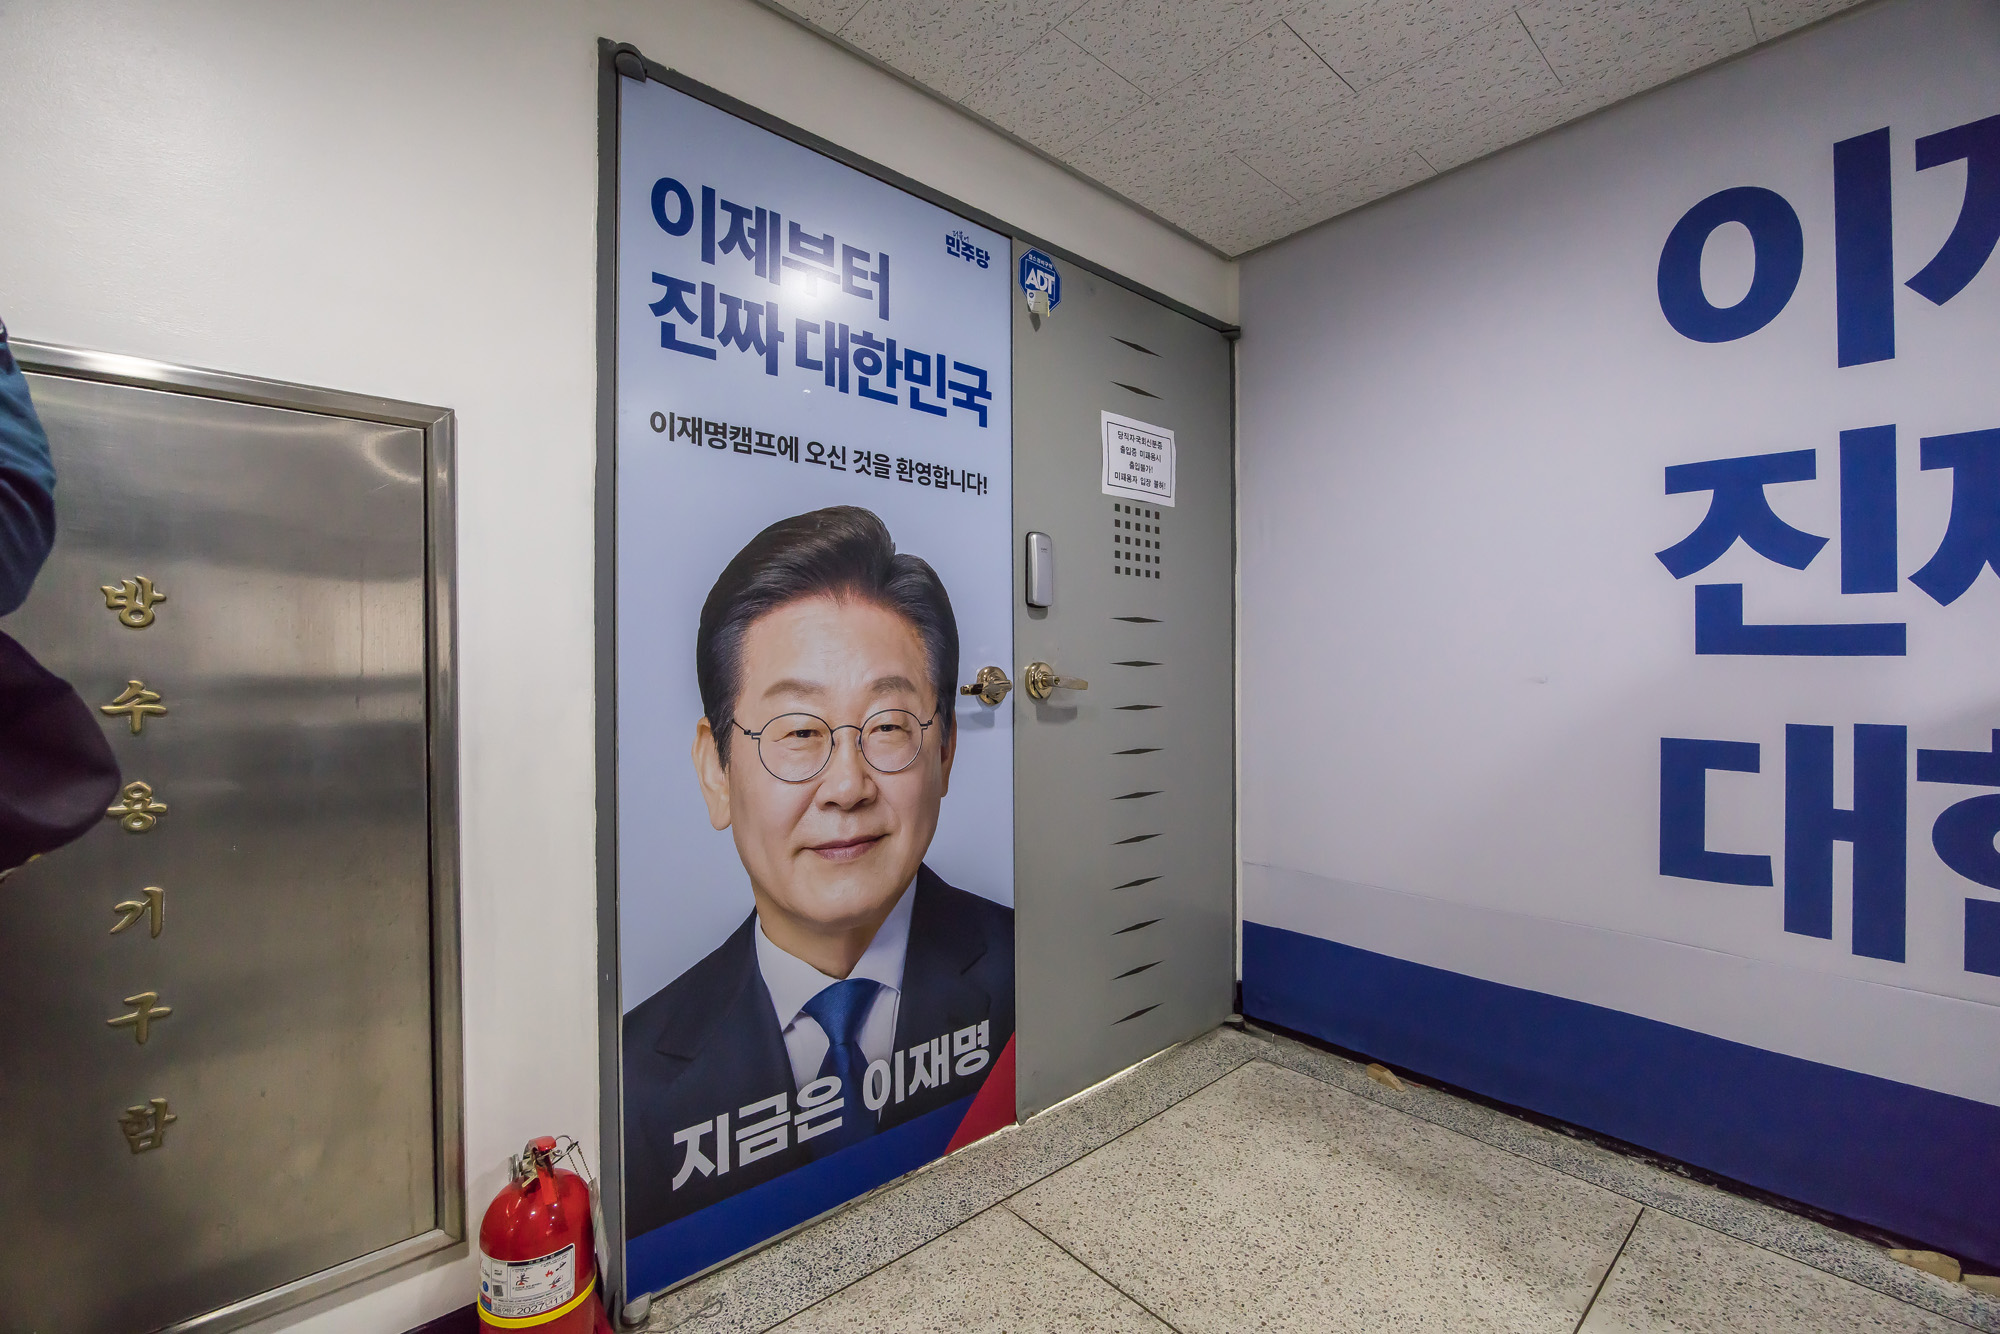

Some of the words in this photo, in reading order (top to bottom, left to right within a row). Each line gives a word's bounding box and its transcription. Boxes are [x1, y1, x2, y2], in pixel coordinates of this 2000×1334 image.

[651, 177, 889, 321] 이제부터
[945, 234, 990, 269] 민주당
[1025, 267, 1055, 295] ADT
[648, 271, 784, 377] 진짜
[795, 318, 992, 428] 대한민국
[649, 410, 799, 463] 이재명캠프에
[805, 441, 847, 472] 오신
[852, 449, 892, 480] 것을
[896, 457, 988, 495] 환영합니다!
[672, 1075, 845, 1191] 지금은
[862, 1019, 990, 1111] 이재명
